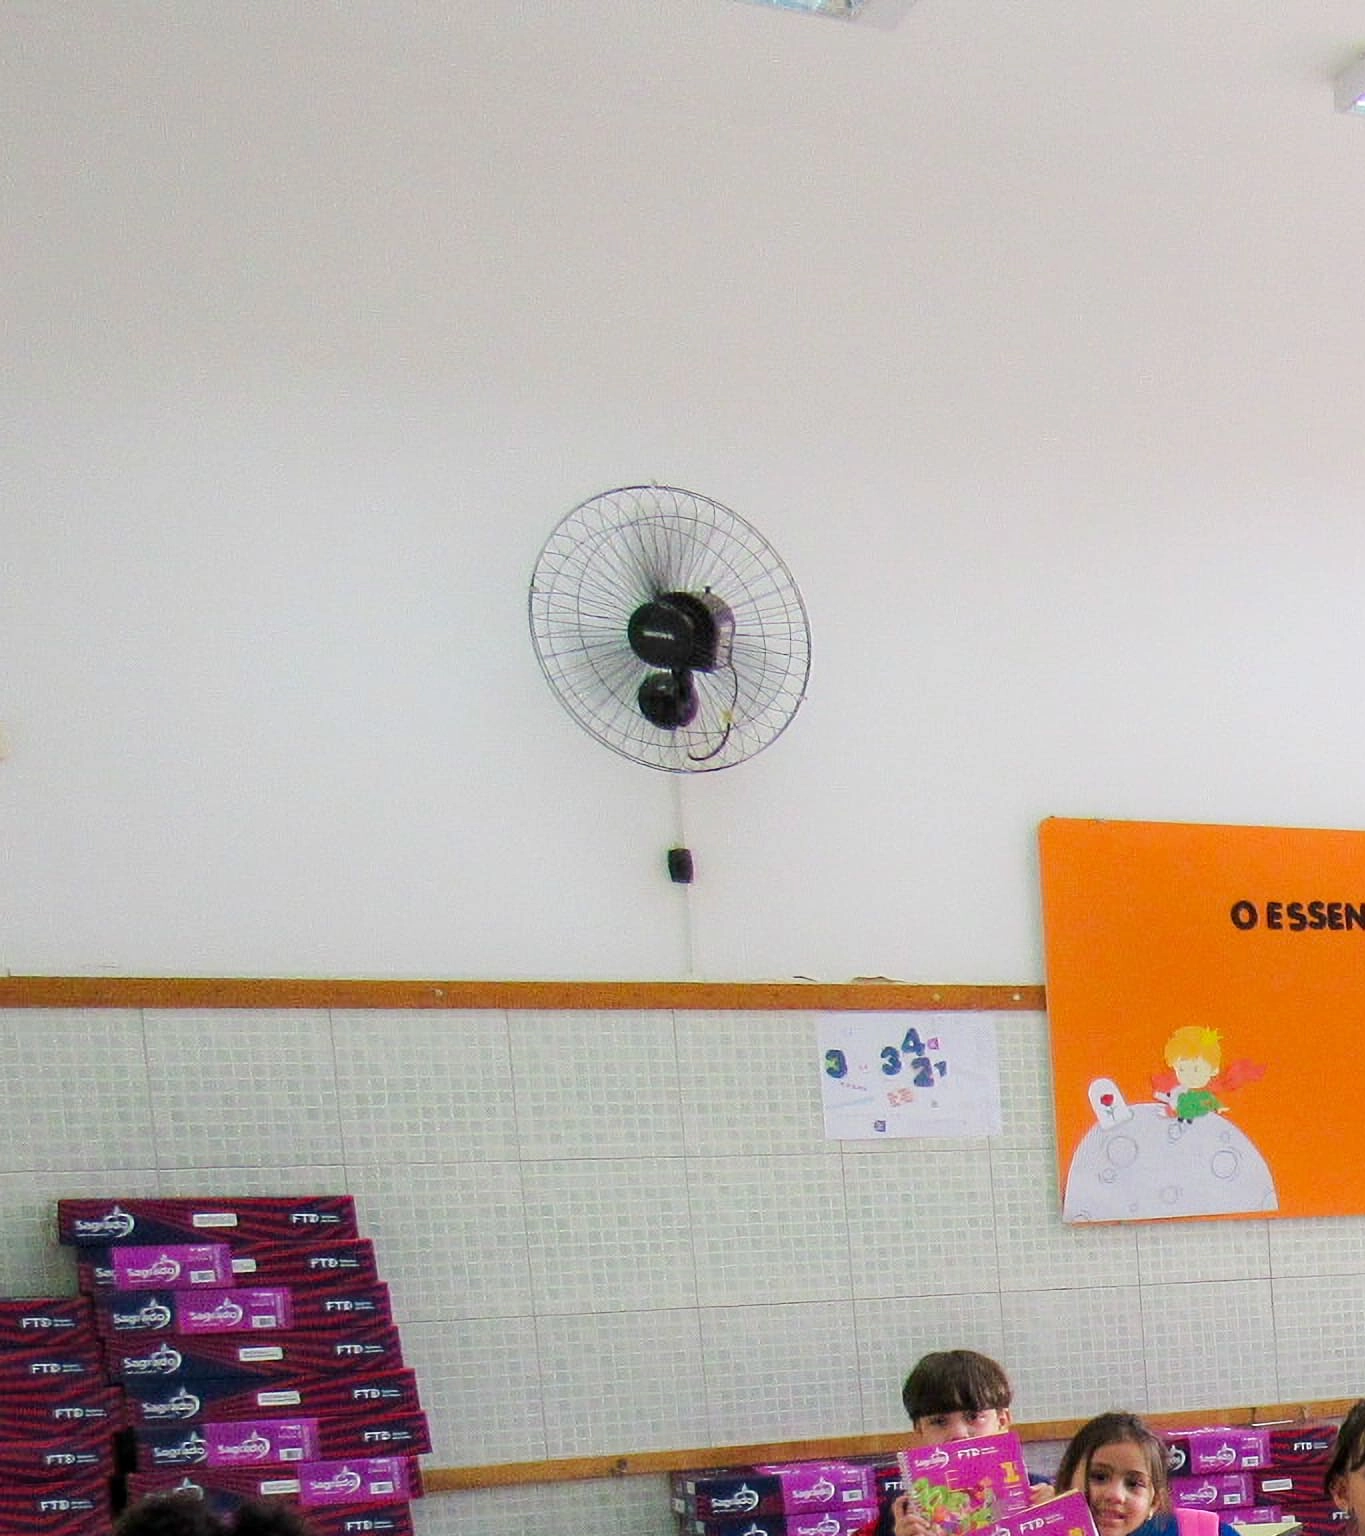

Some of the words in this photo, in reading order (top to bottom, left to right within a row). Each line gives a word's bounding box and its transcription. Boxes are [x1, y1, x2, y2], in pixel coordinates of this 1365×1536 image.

[1230, 901, 1258, 931] O
[901, 1028, 925, 1056] 4
[881, 1046, 902, 1075] 3
[1000, 1461, 1020, 1483] 1
[1020, 1518, 1044, 1535] FTD
